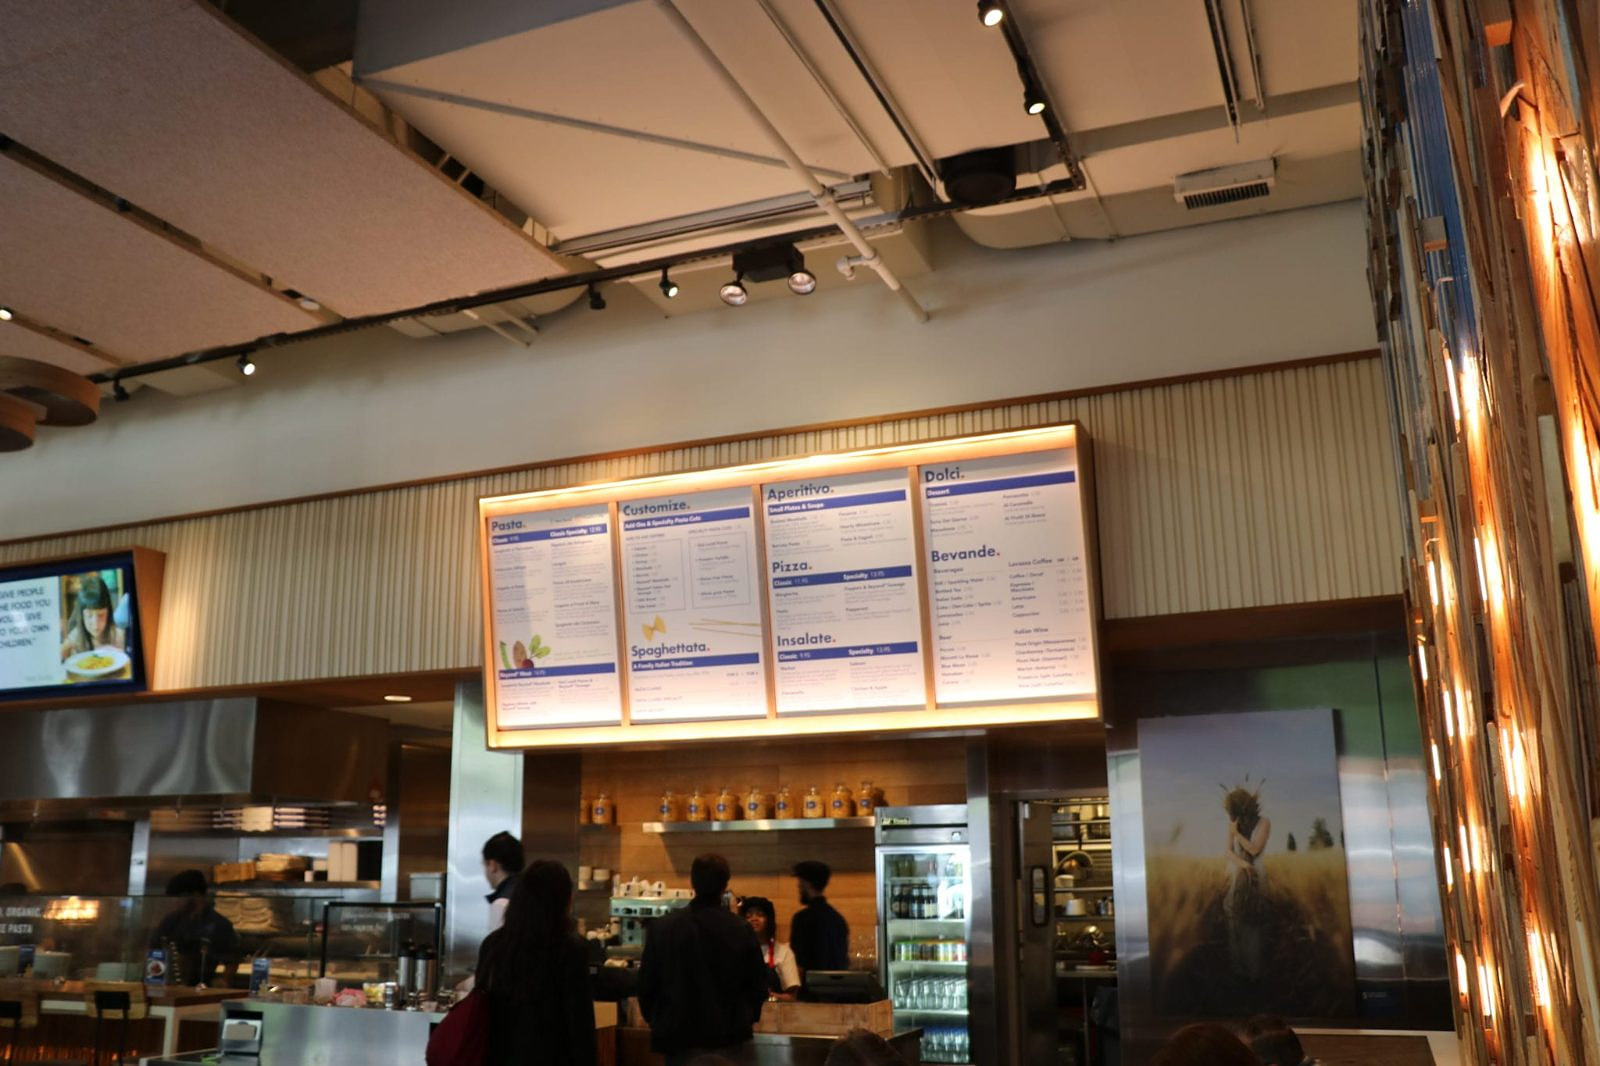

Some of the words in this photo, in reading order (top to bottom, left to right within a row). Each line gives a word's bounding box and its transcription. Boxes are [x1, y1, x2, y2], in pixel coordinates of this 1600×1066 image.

[925, 467, 964, 482] Dolci.
[767, 483, 834, 502] Aperitivo.
[927, 489, 950, 497] Dessert
[623, 500, 690, 516] Customize.
[491, 519, 526, 532] Pasta.
[931, 545, 1000, 562] Bevande.
[772, 560, 812, 573] Pizza.
[777, 632, 836, 647] Insalate.
[631, 642, 711, 658] Spaghettata.
[848, 648, 874, 656] Specialty
[8, 923, 34, 934] PASTA
